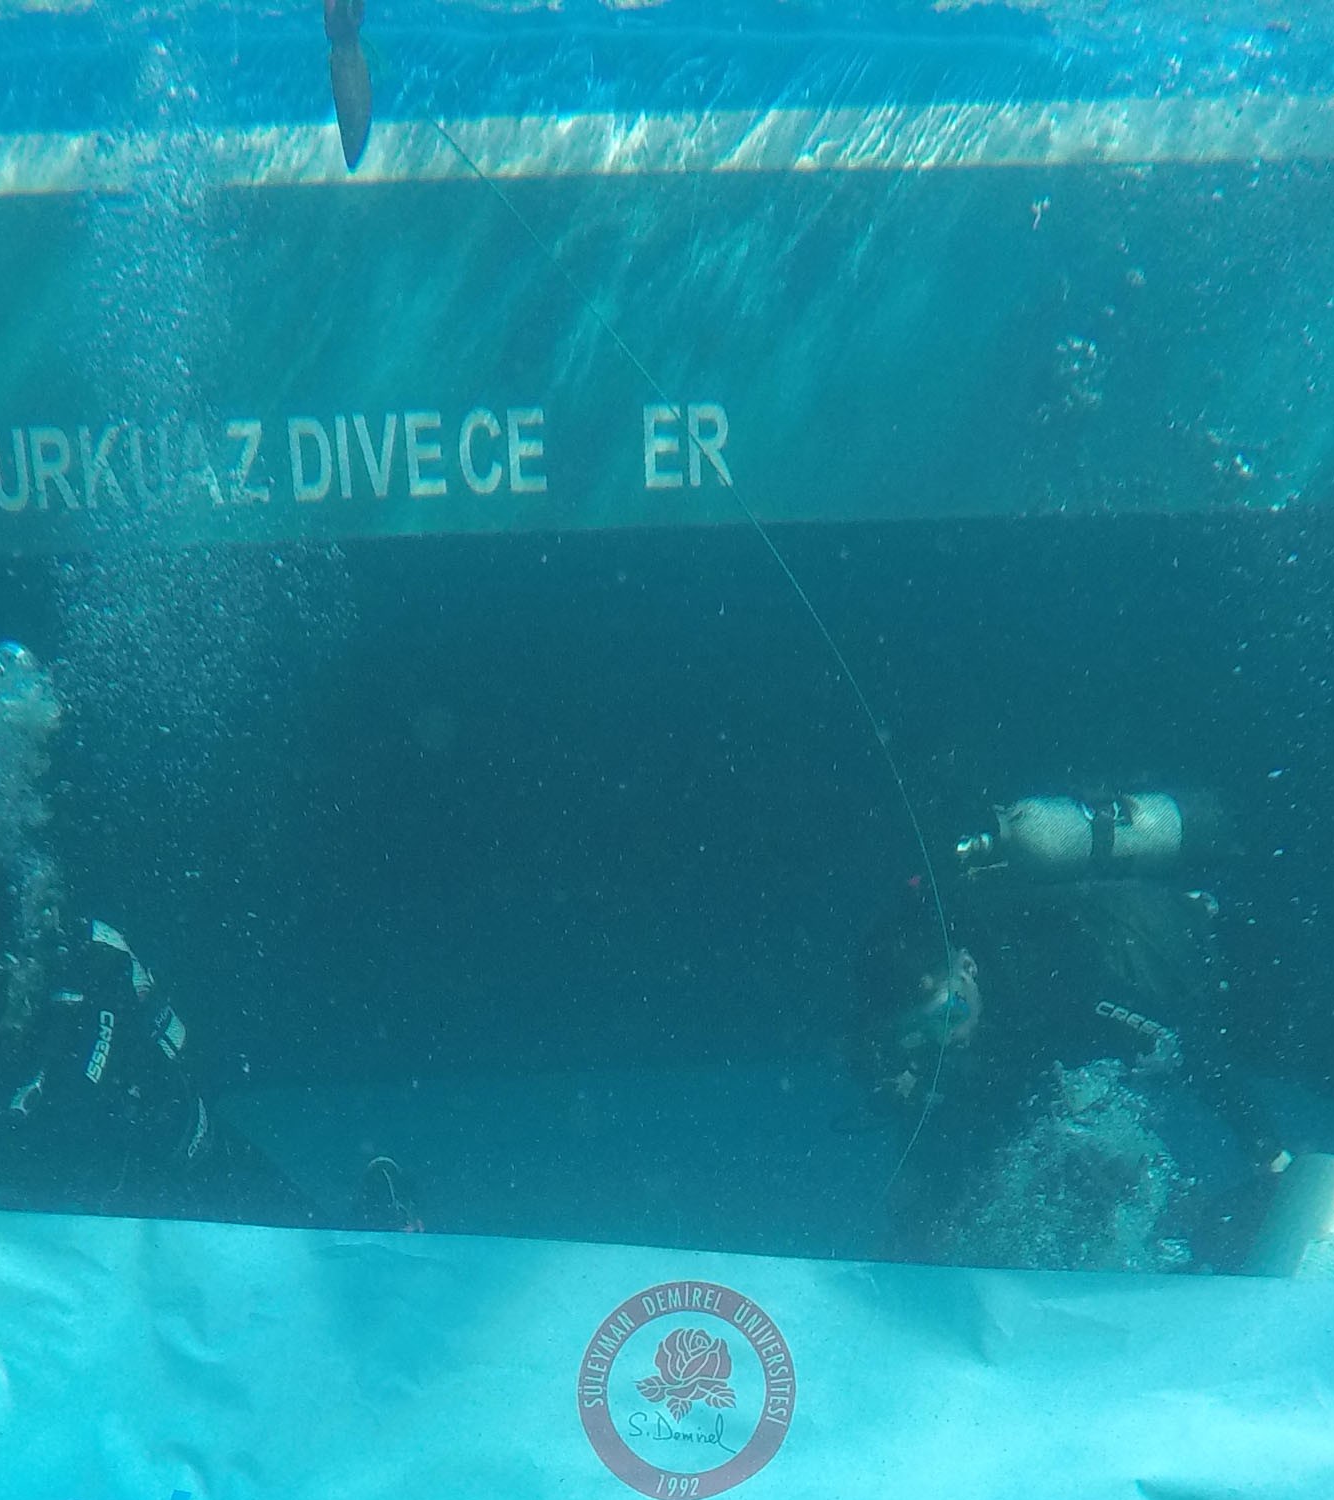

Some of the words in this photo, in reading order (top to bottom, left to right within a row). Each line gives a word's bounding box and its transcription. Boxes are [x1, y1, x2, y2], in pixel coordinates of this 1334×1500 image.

[288, 410, 447, 501] DIVE
[86, 1010, 114, 1083] CRESSI
[578, 1311, 636, 1408] SÜLEYMAN
[656, 1475, 699, 1497] 1992
